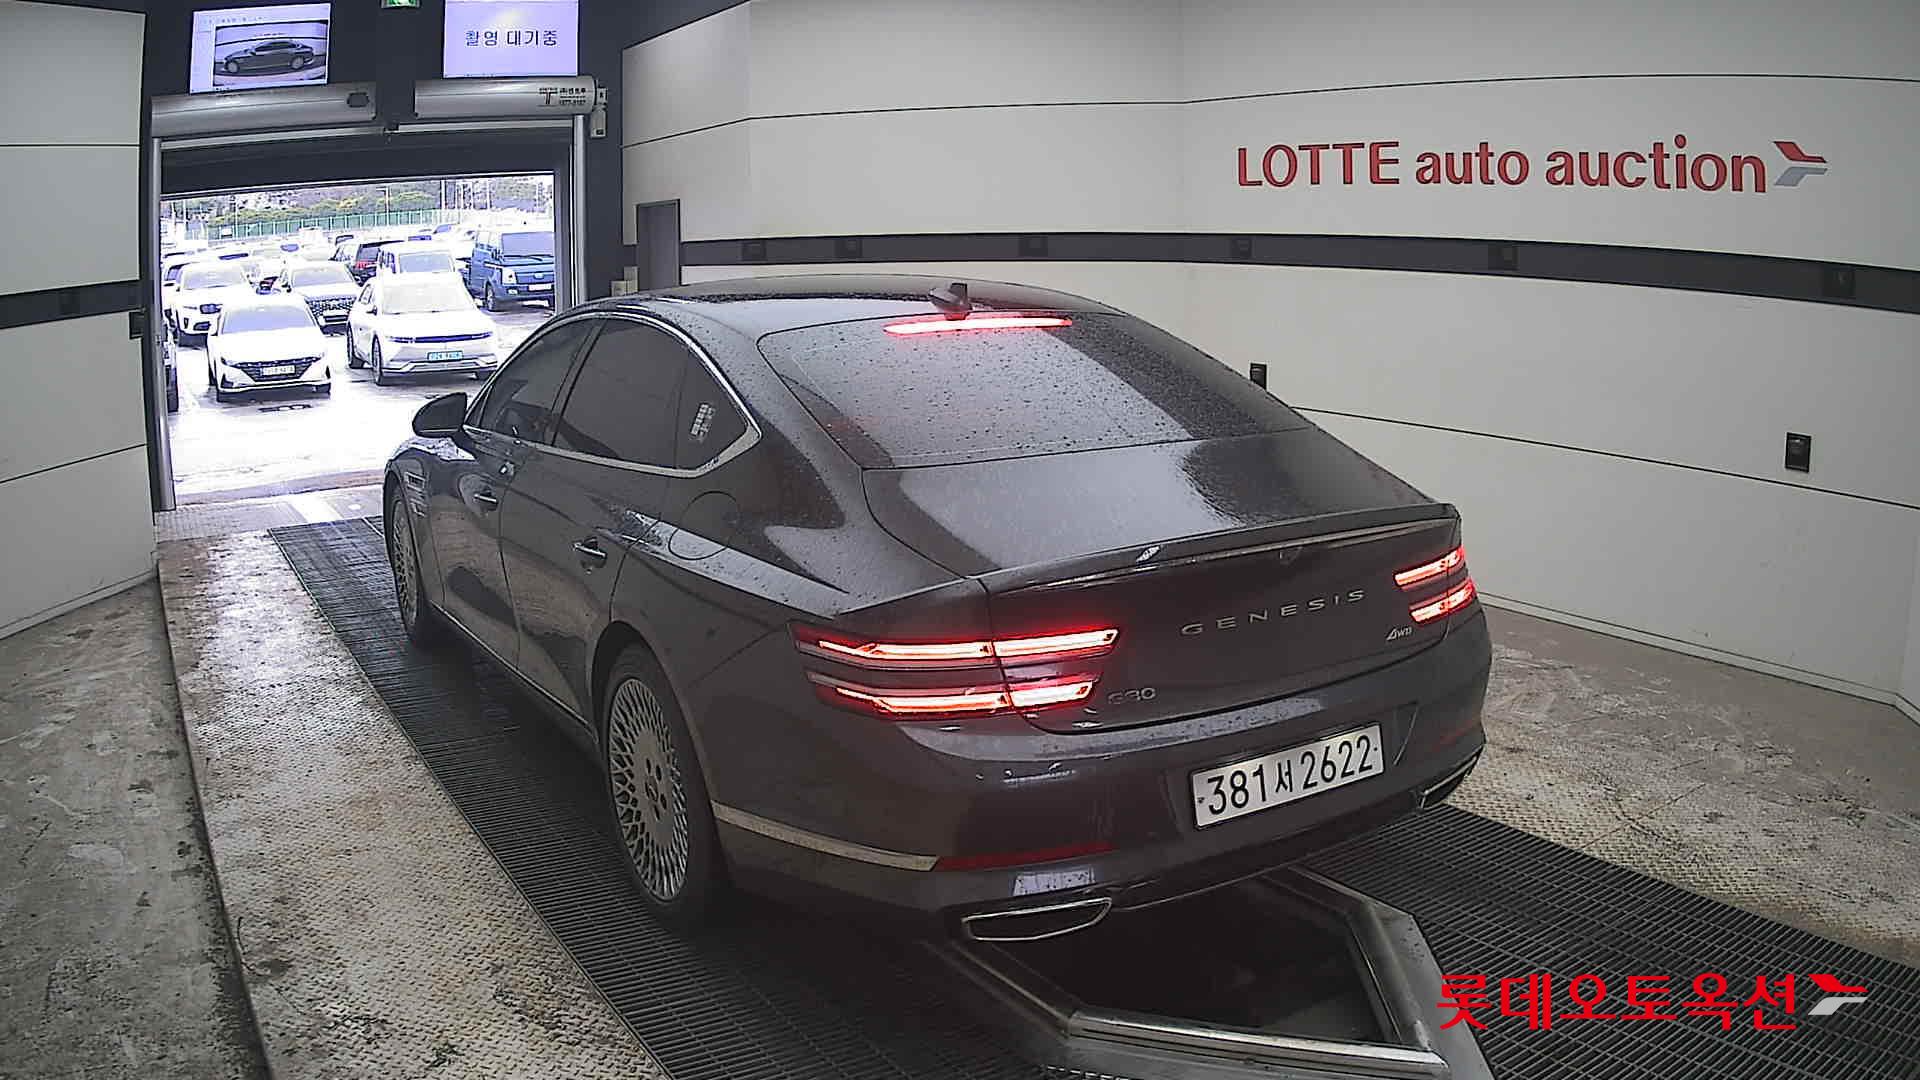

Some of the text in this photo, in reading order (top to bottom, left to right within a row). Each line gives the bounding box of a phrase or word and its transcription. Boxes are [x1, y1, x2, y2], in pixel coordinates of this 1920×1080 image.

[506, 30, 557, 47] 대기중
[1237, 134, 1768, 194] LOTTE auto auction
[1180, 588, 1366, 637] GENESIS
[1206, 733, 1375, 816] 381서2622
